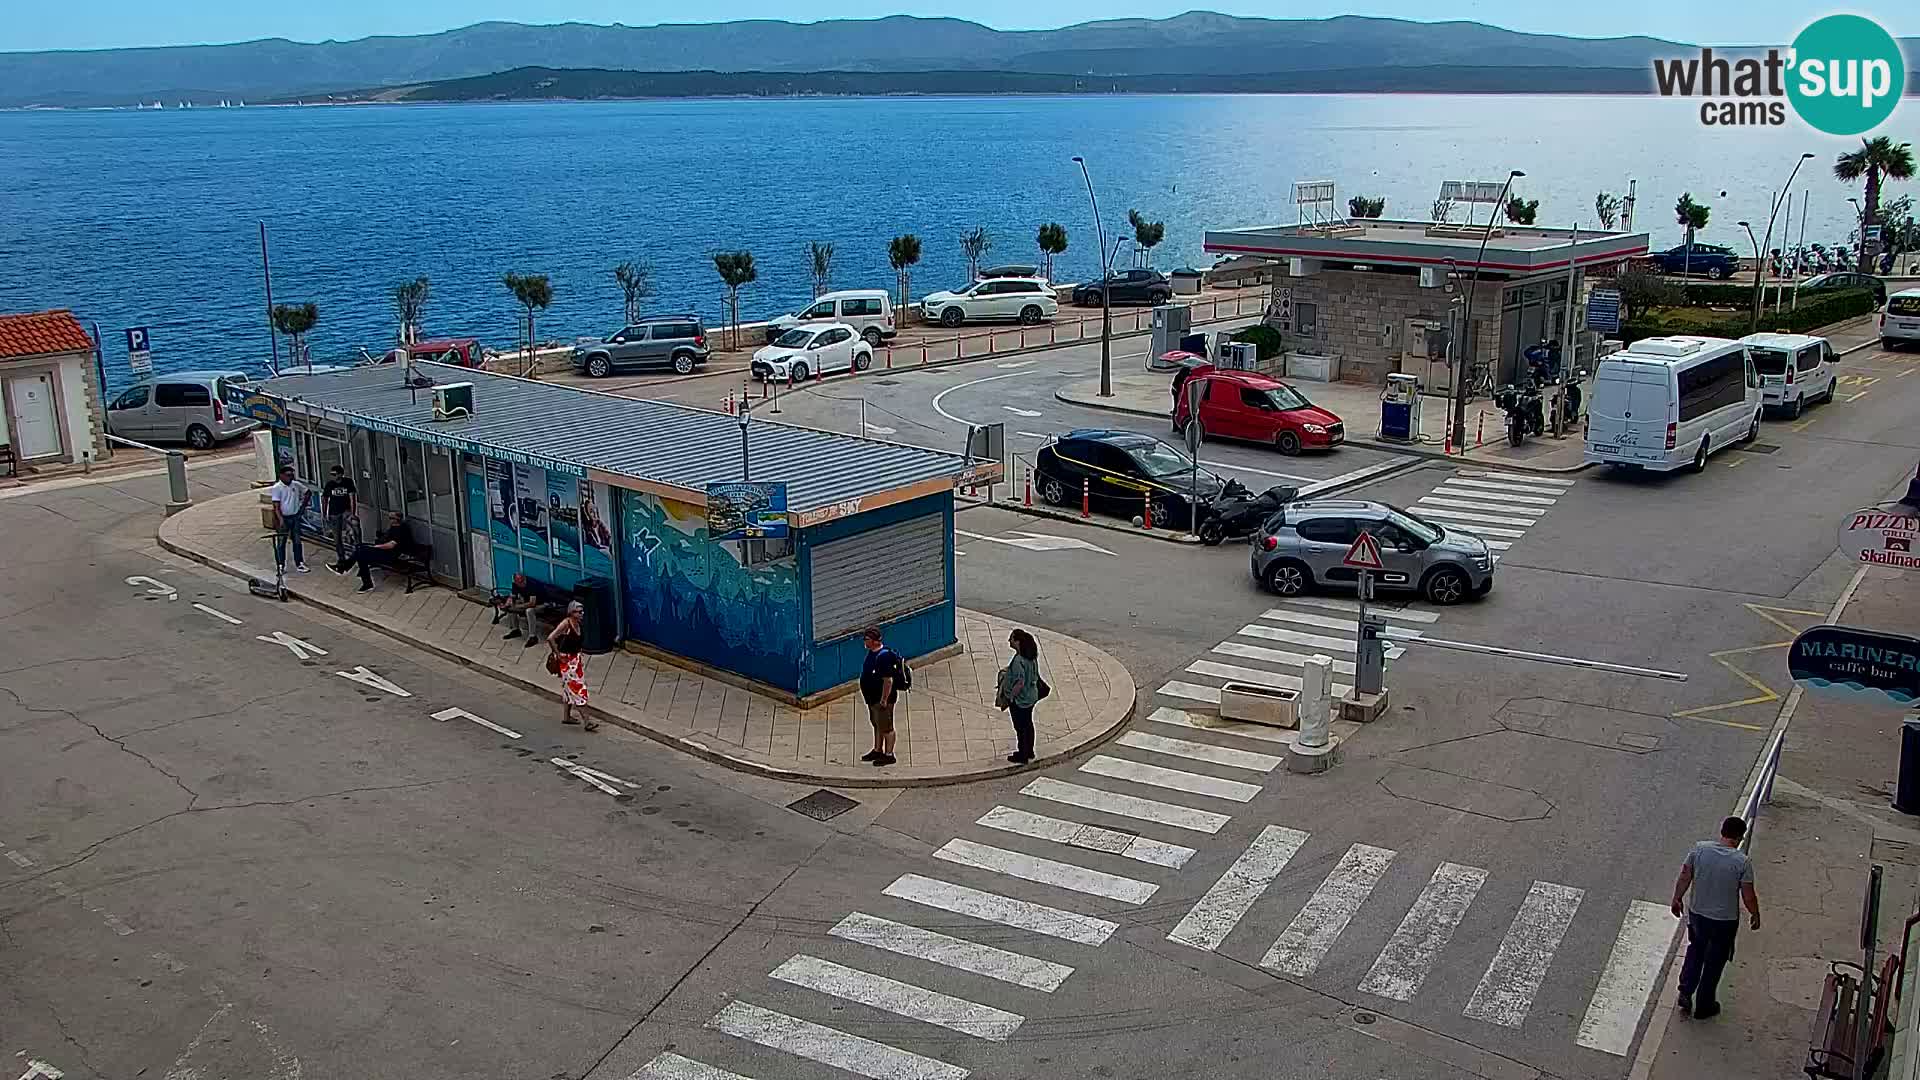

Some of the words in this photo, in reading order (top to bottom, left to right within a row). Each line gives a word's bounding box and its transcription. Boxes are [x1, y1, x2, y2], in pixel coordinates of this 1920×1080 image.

[396, 426, 437, 444] AUTOBUSNA
[437, 435, 469, 451] POSTAJA
[479, 444, 494, 457] BUS
[494, 449, 527, 464] STATION
[529, 456, 554, 471] TICKET
[556, 463, 583, 476] OFFICE
[1847, 514, 1920, 533] PIZZE
[1882, 530, 1917, 540] GRILL
[1829, 661, 1867, 674] caffe
[1871, 665, 1898, 680] bar
